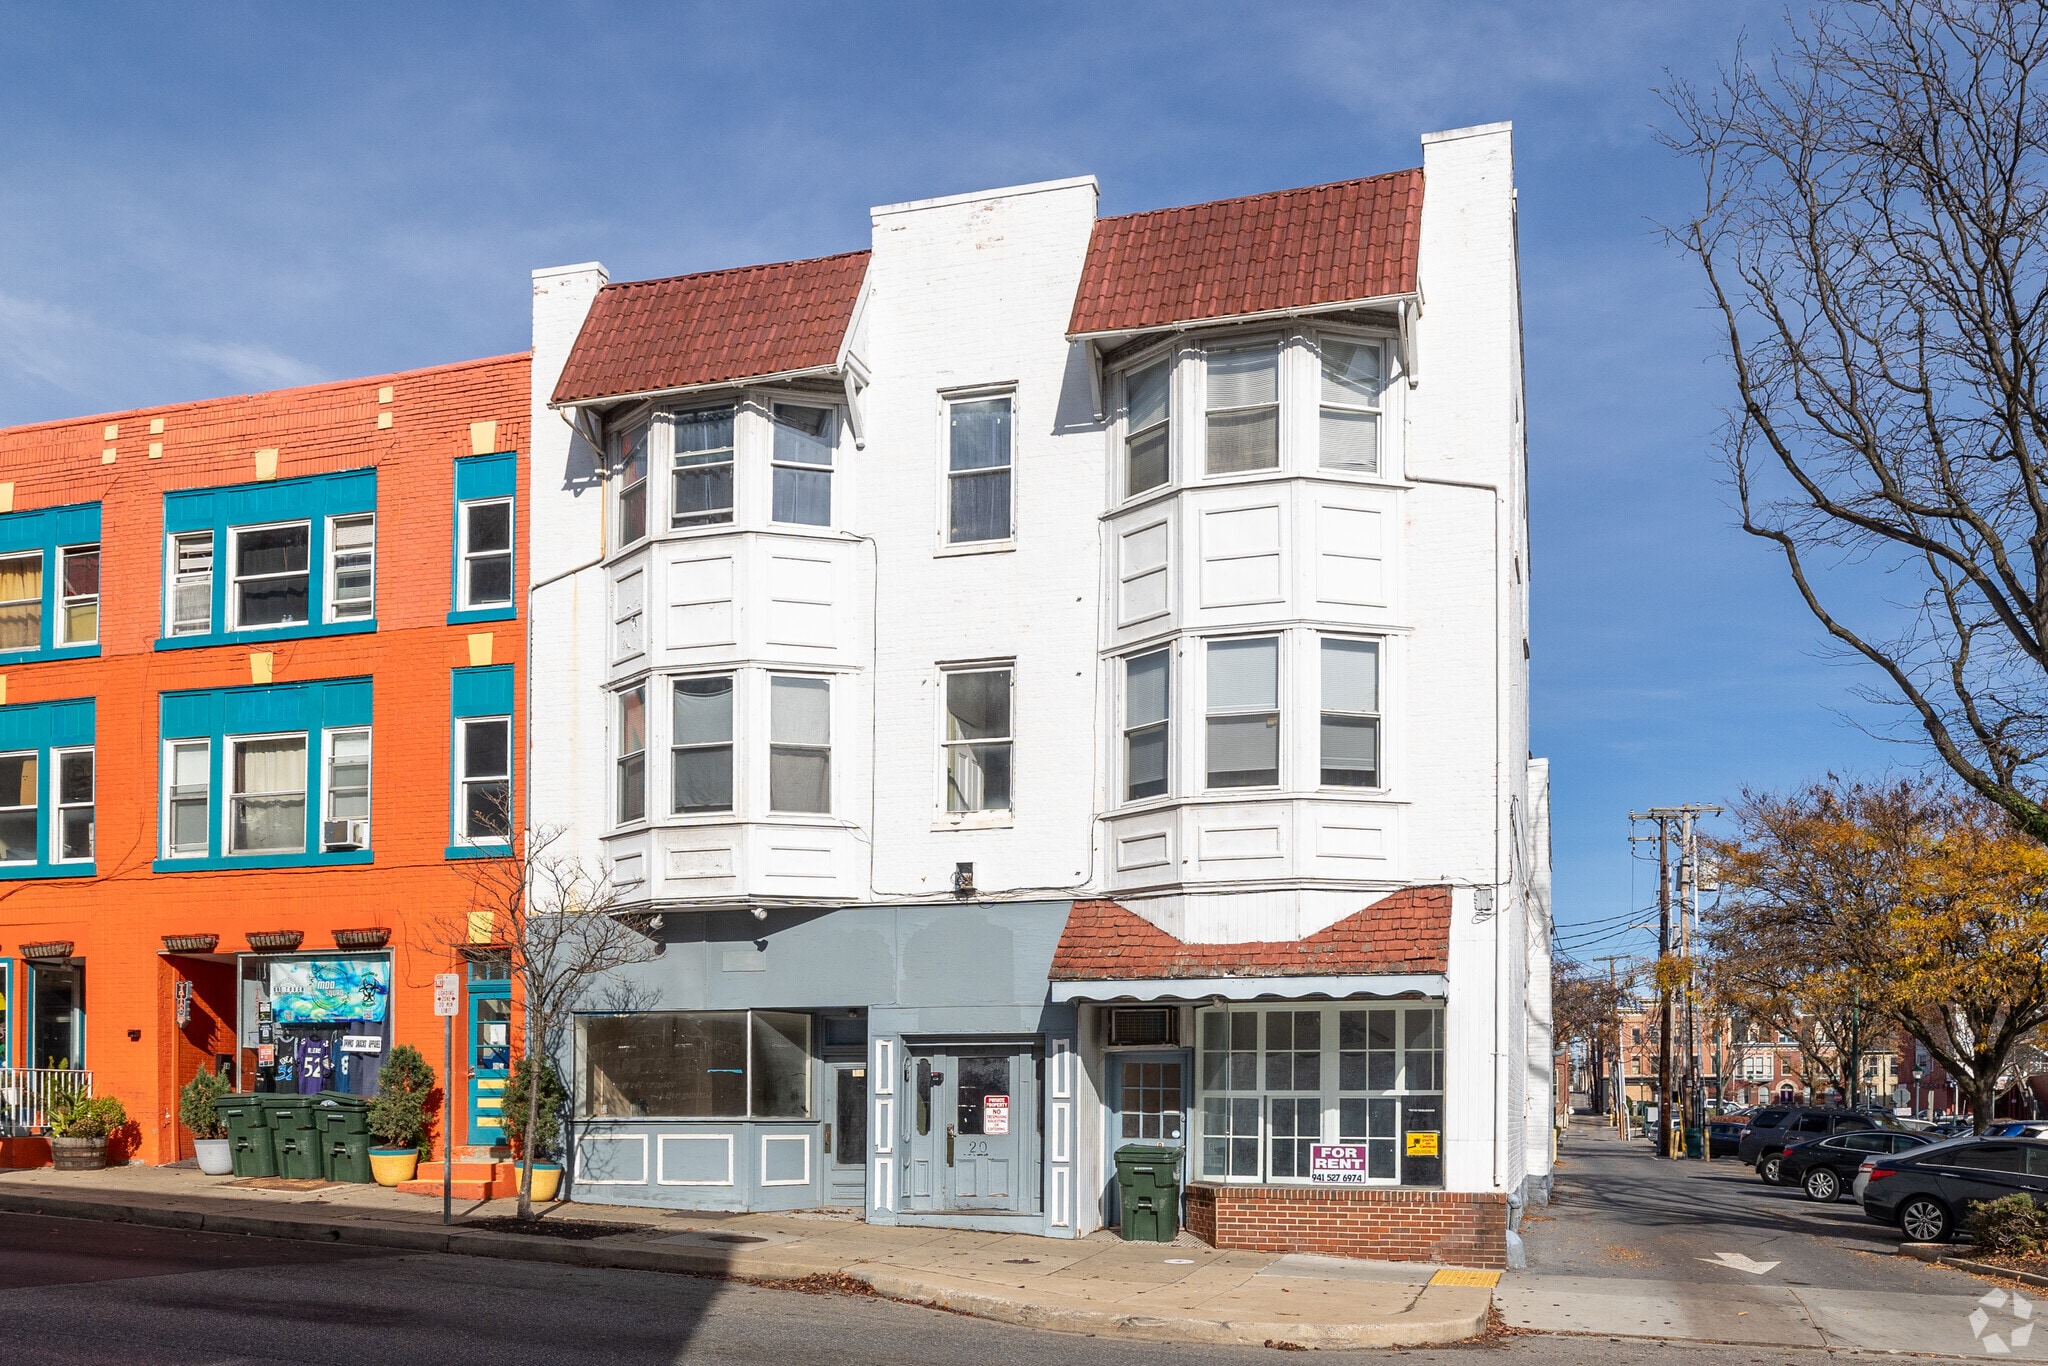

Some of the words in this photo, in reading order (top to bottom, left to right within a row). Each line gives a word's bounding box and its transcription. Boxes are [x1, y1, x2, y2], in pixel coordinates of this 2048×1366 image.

[970, 1141, 987, 1153] 20
[1321, 1148, 1357, 1158] FOR
[1315, 1158, 1363, 1169] RENT
